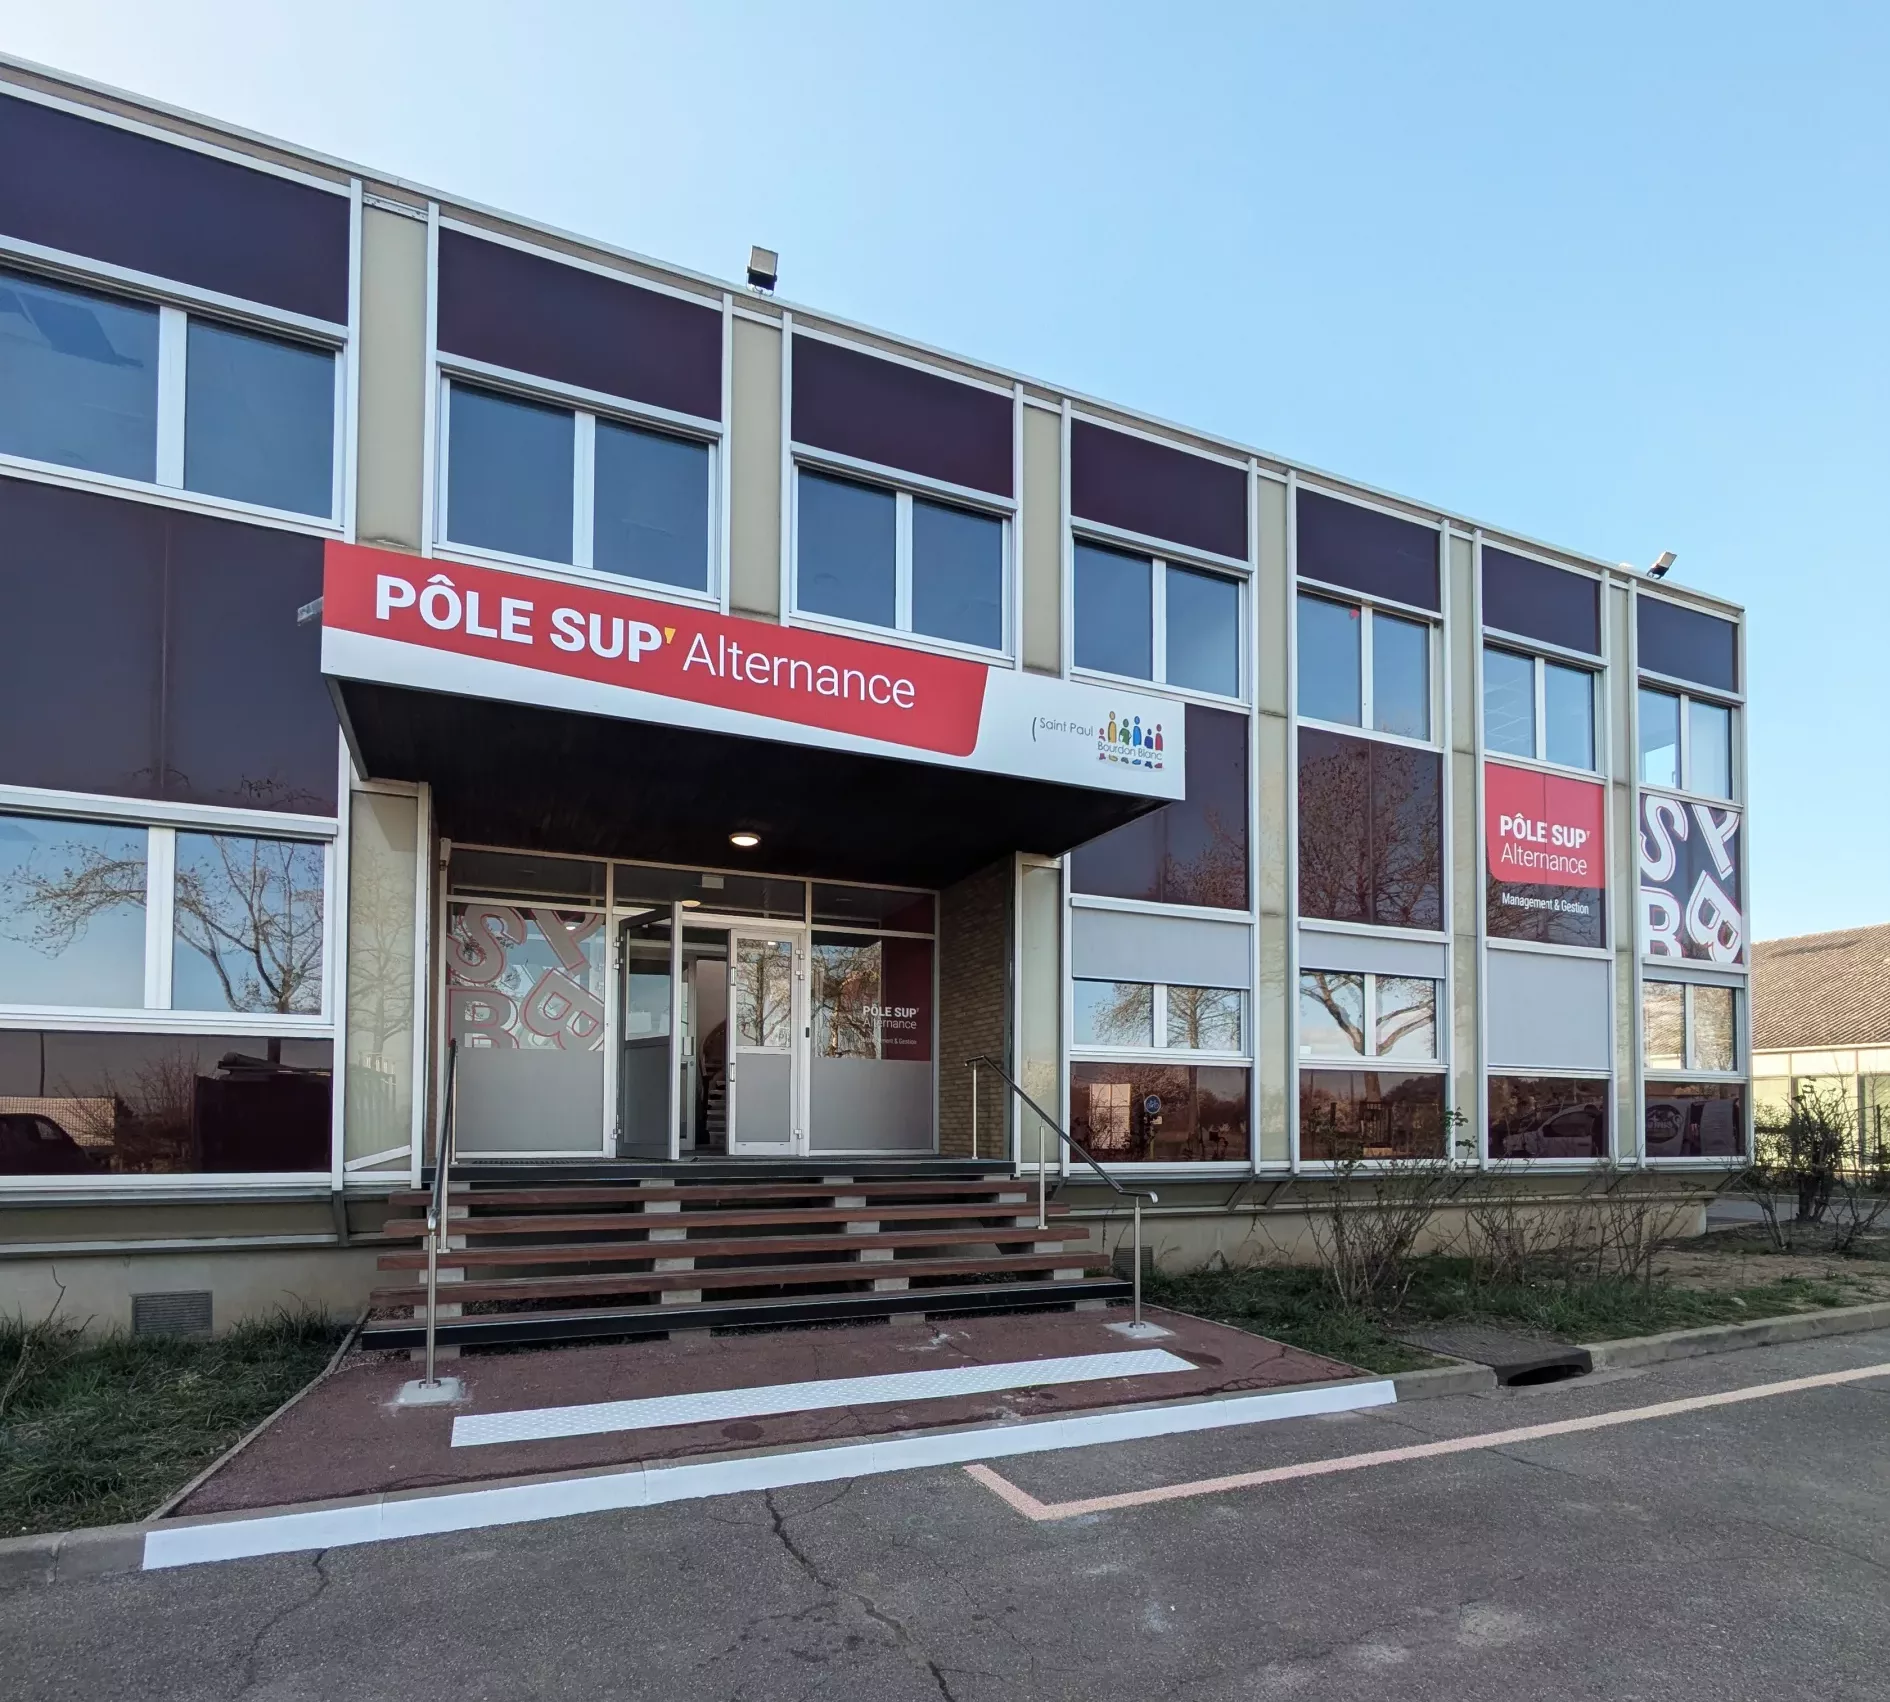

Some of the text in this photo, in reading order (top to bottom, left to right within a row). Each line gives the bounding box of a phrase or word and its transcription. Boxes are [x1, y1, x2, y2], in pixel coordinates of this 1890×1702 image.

[376, 574, 534, 644] PÔLE
[682, 632, 915, 709] Alternance
[1069, 722, 1094, 737] Paul
[1097, 740, 1163, 761] Bourdon Blanc
[1500, 812, 1547, 843] PÔLE
[1501, 842, 1587, 875] Alternance
[1502, 892, 1589, 915] Management & Gestion
[862, 1003, 892, 1017] PÔLE
